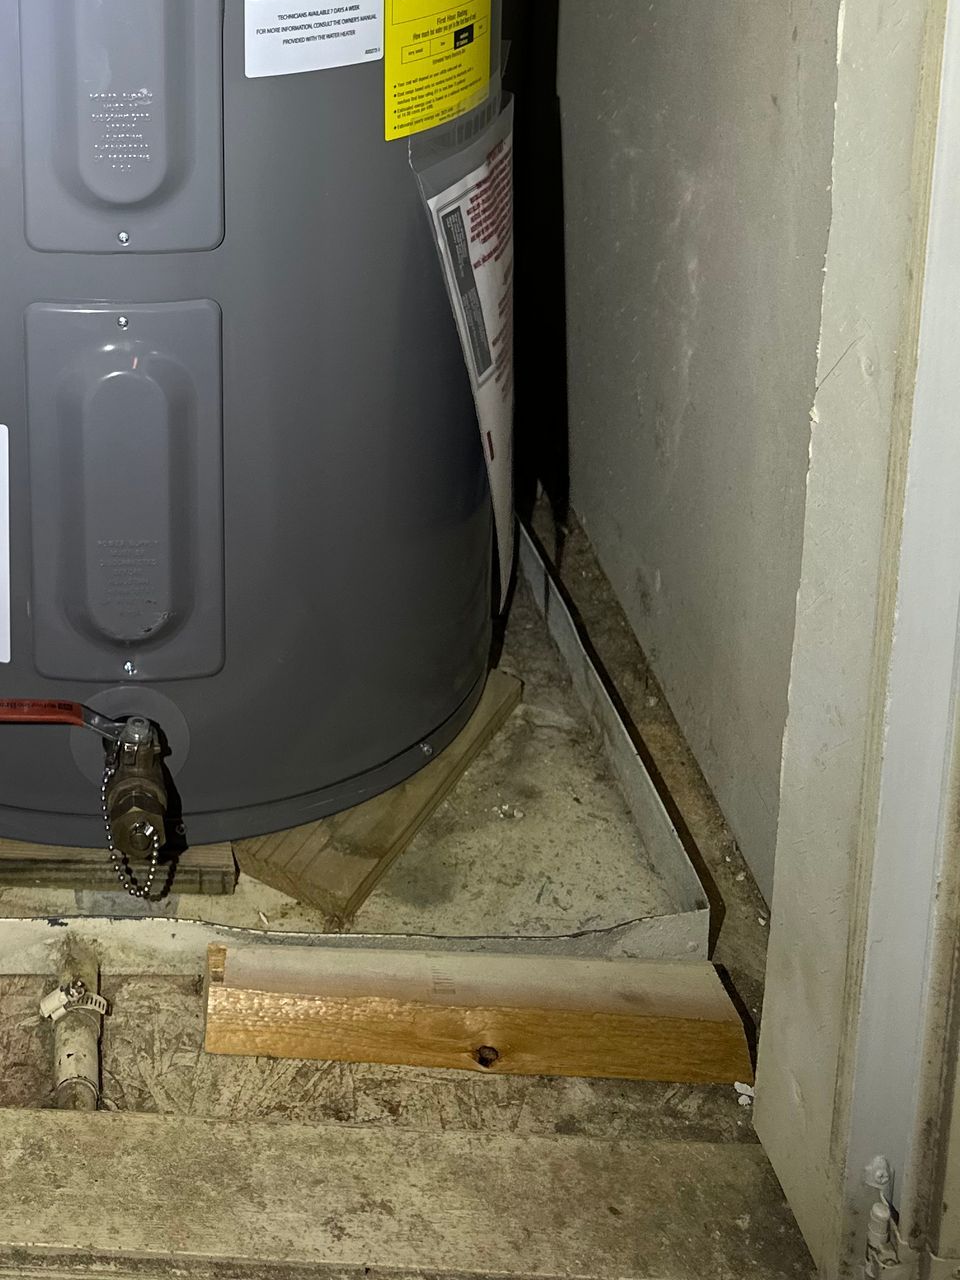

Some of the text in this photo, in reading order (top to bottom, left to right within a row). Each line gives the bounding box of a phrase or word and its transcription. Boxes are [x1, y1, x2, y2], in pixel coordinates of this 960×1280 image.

[278, 12, 307, 21] TECHNICIANS
[314, 21, 332, 29] CONSULT
[360, 14, 377, 22] MANUAL
[283, 37, 305, 45] PROVIDED
